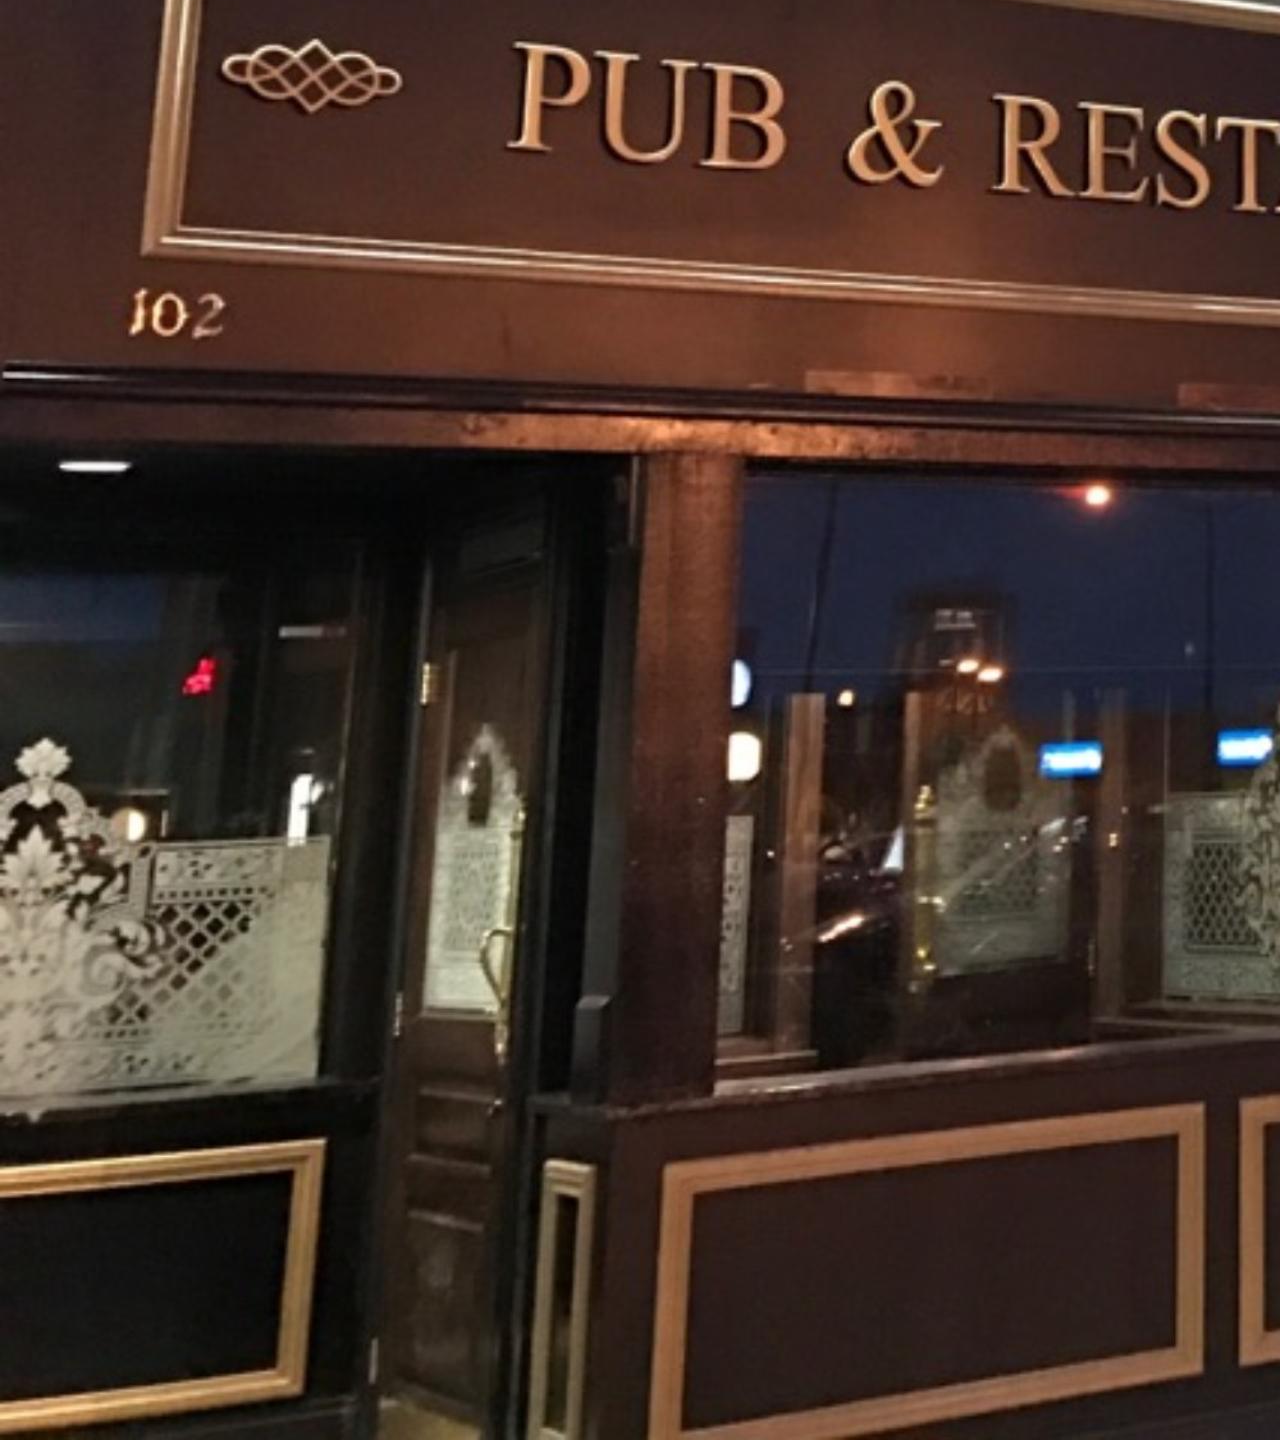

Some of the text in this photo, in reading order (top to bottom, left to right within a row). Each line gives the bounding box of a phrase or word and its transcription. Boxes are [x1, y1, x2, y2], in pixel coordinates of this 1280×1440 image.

[506, 41, 787, 169] PUB
[847, 80, 944, 188] &
[128, 287, 226, 339] 102
